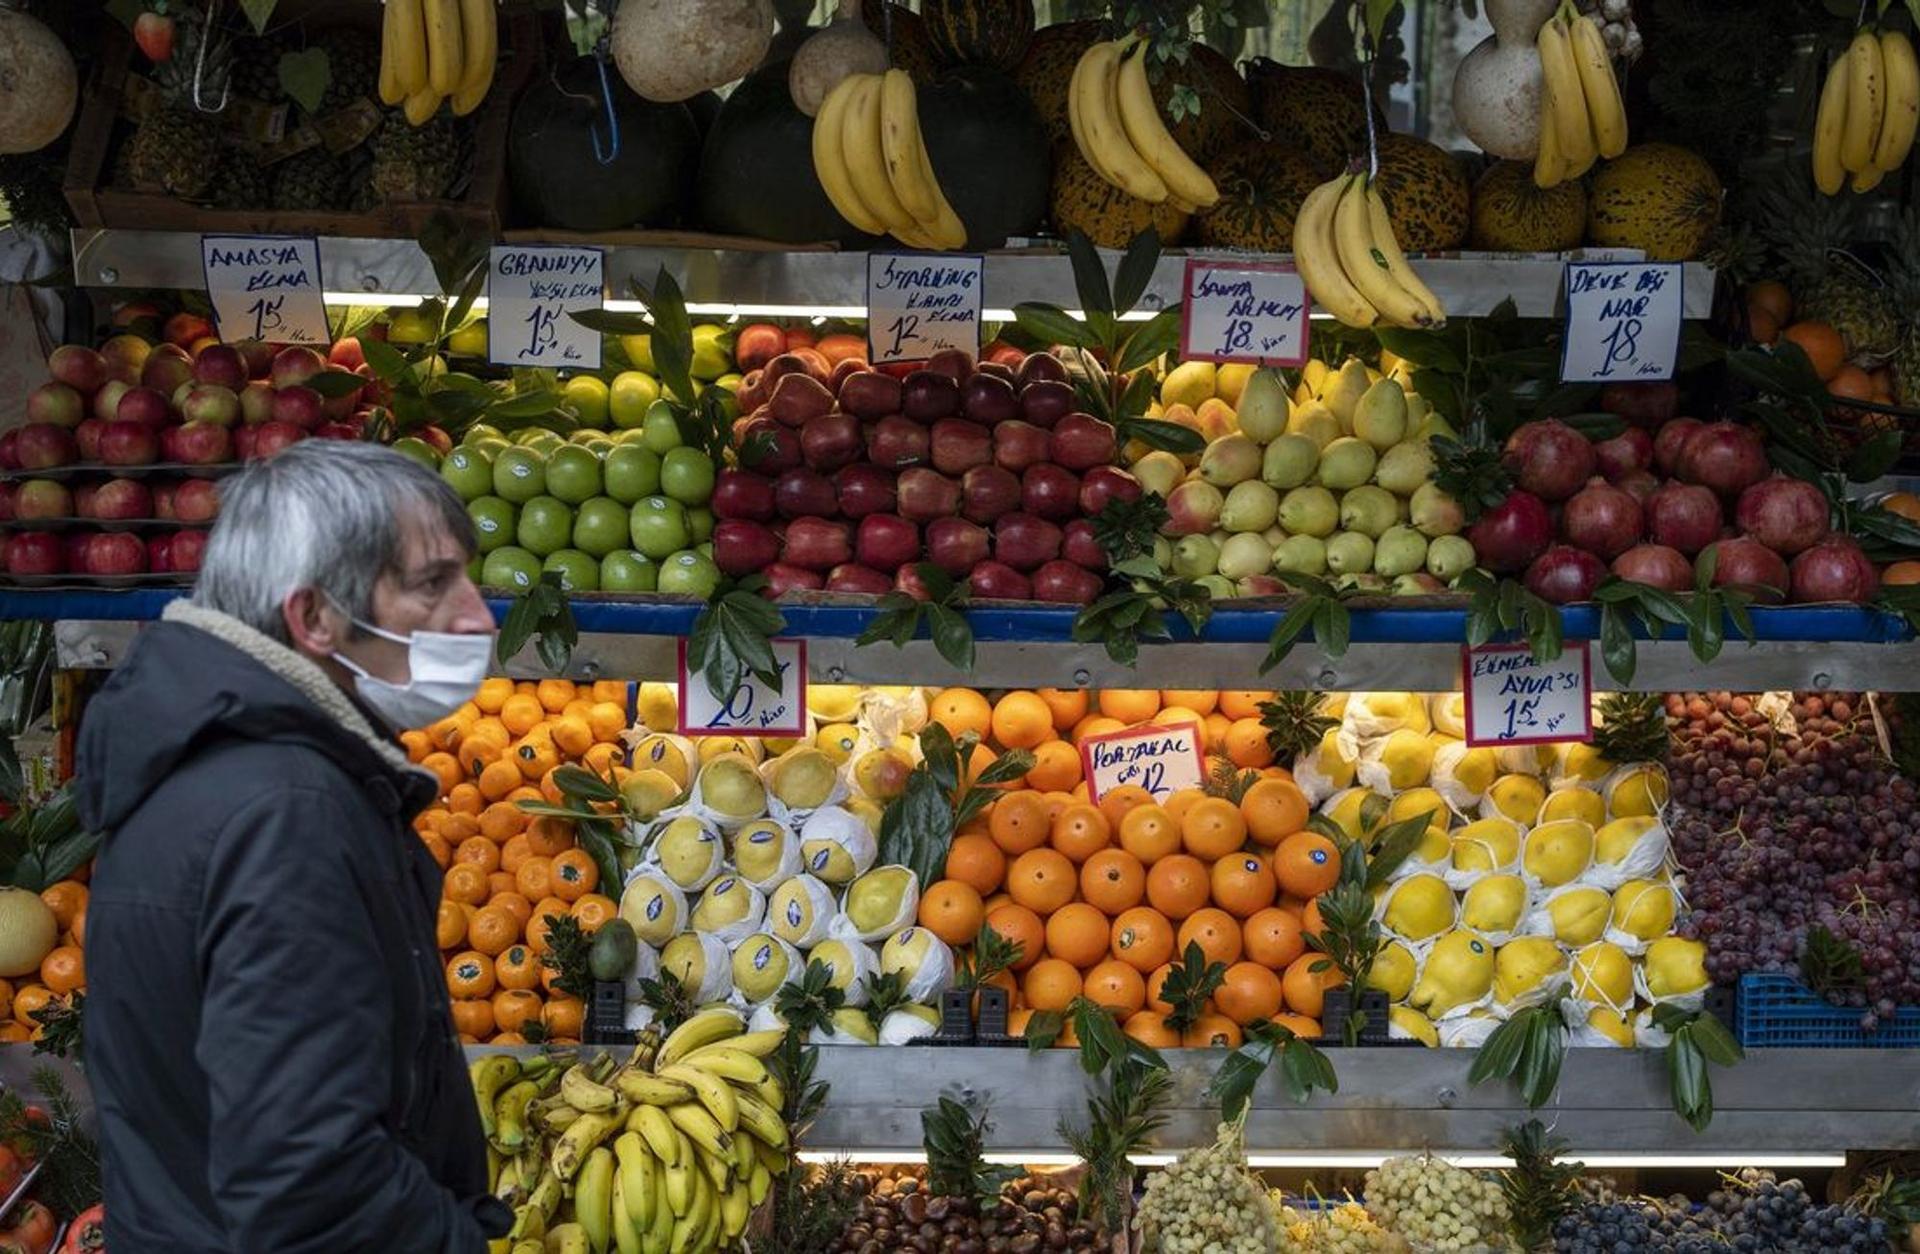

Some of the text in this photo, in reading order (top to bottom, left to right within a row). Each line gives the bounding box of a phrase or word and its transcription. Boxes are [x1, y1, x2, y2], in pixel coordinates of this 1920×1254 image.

[209, 247, 302, 267] AMASYA
[1571, 269, 1629, 293] DEVE
[1599, 297, 1649, 320] NAR
[1215, 319, 1253, 354] 18
[1592, 319, 1642, 376] 18
[1142, 763, 1169, 795] 12
